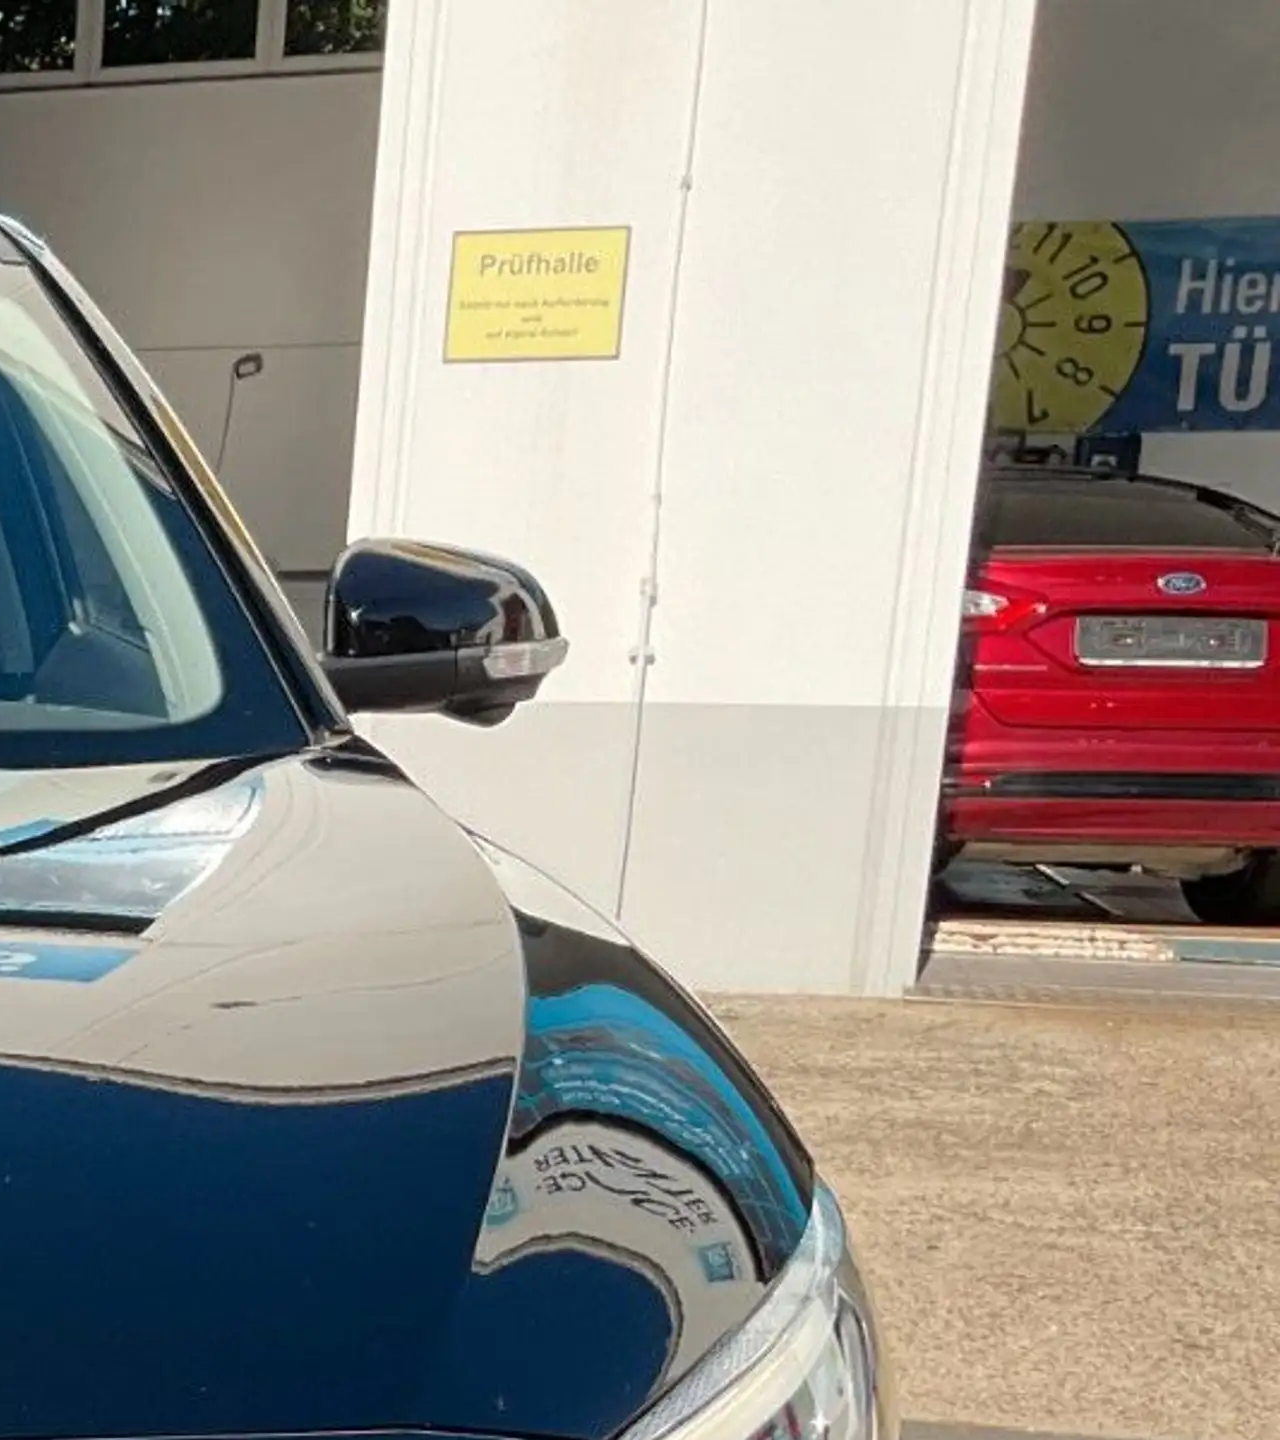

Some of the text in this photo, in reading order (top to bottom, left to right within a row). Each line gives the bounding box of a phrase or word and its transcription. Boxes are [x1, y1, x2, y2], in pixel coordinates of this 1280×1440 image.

[479, 251, 600, 277] Prüfhalle
[1061, 254, 1109, 300] 10
[1073, 313, 1113, 334] 9
[1055, 356, 1095, 387] 8
